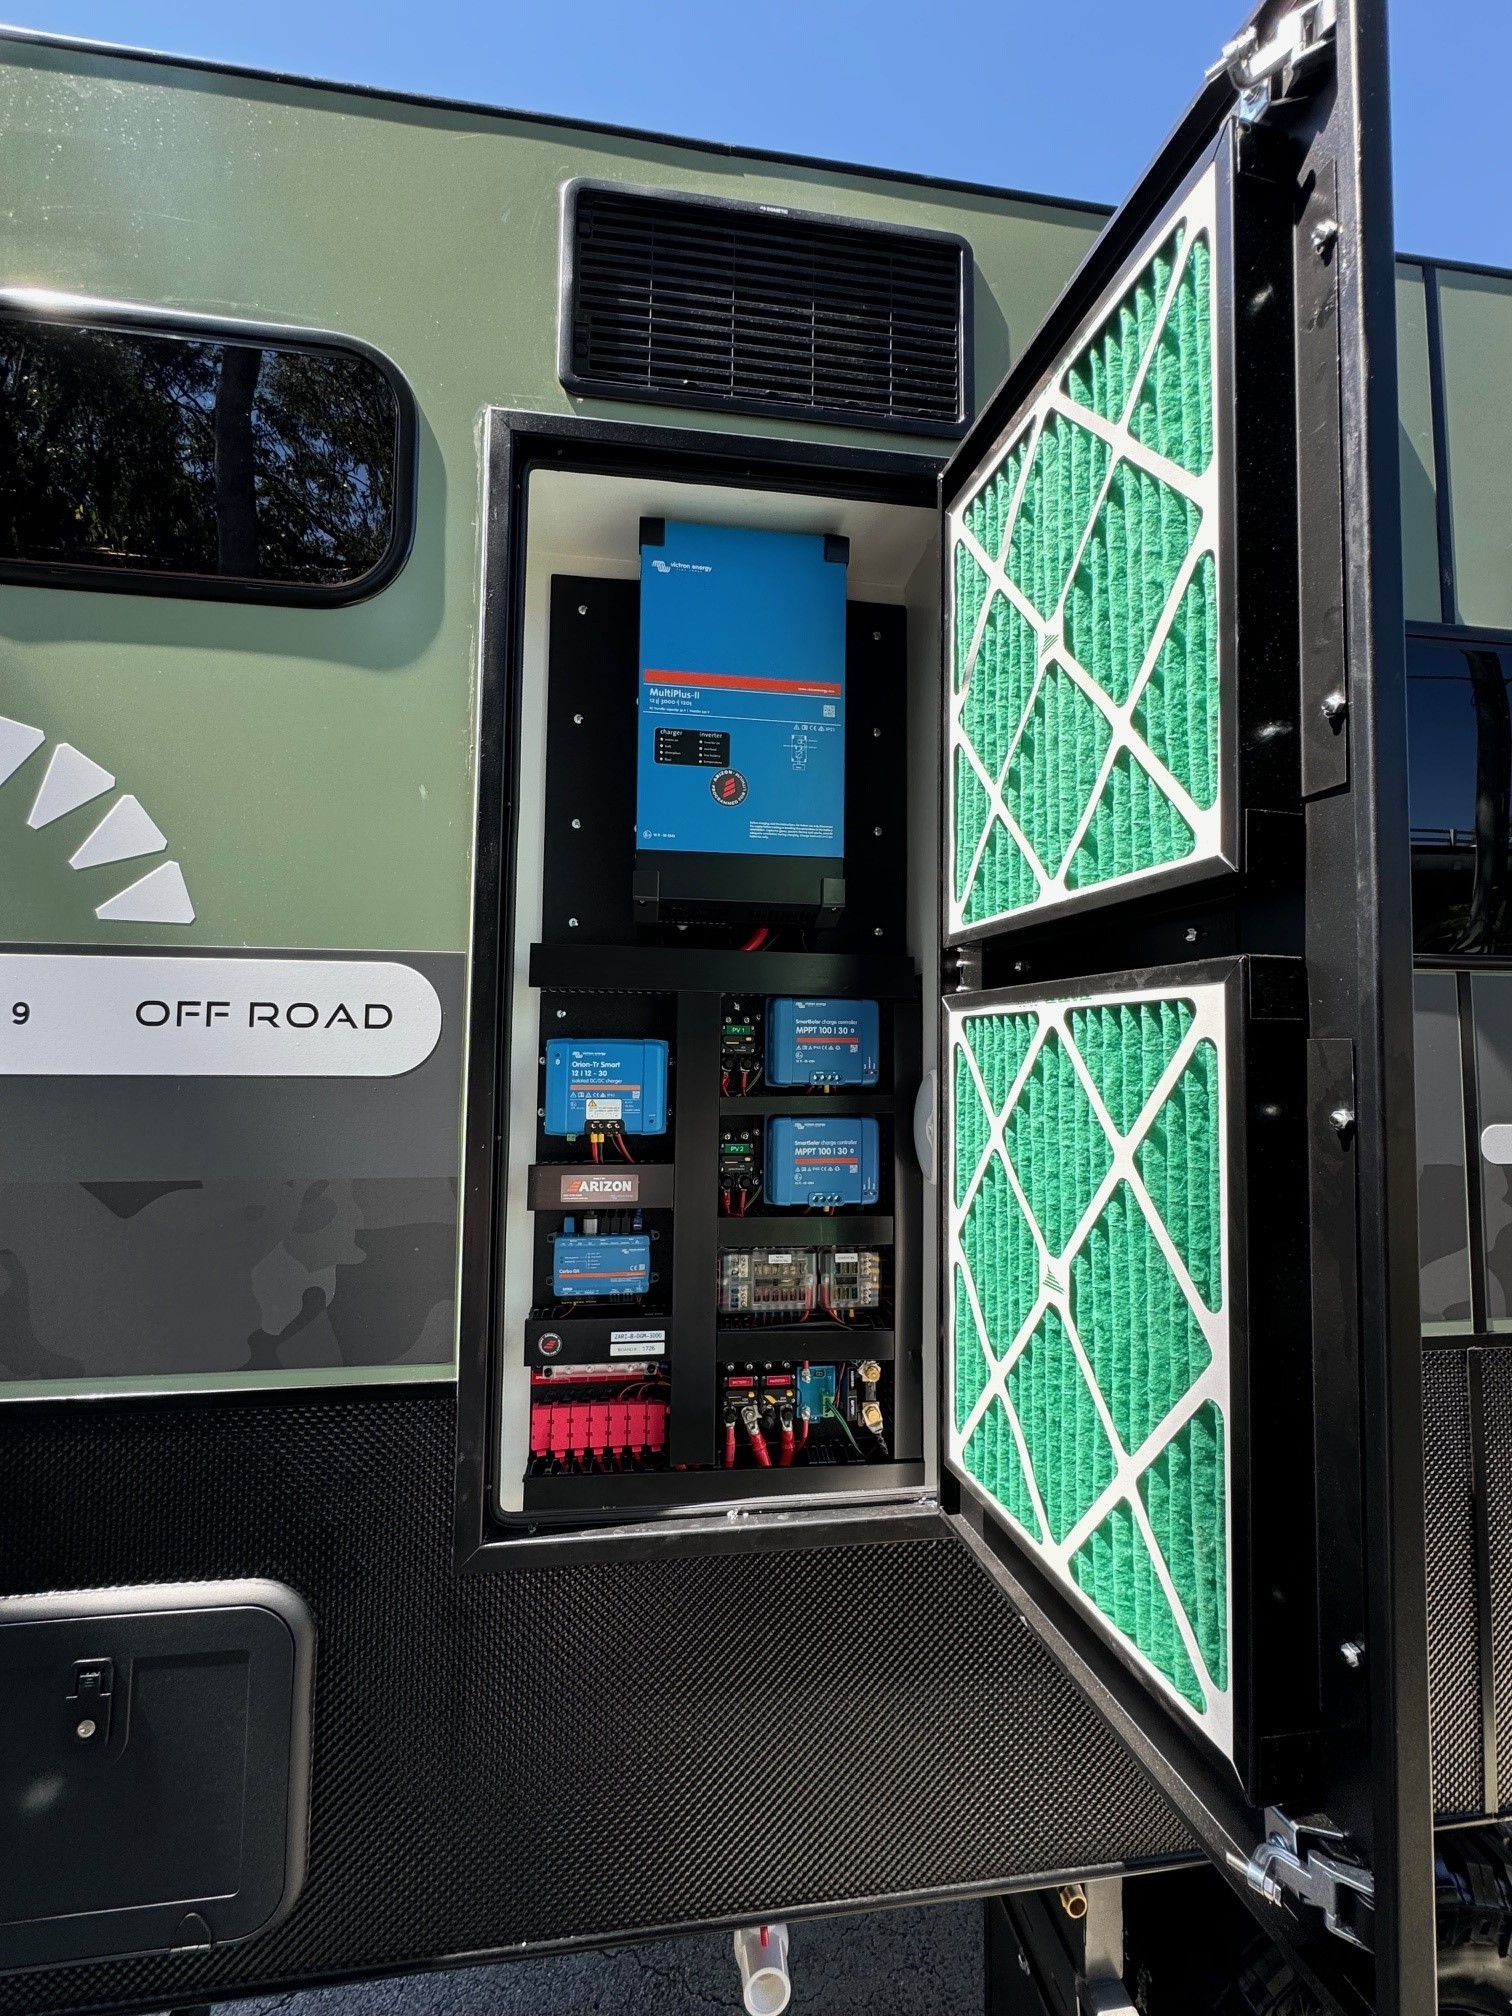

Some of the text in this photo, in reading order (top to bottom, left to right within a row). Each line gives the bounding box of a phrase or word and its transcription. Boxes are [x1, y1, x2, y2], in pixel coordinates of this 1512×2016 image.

[12, 1002, 30, 1025] 9
[136, 1000, 394, 1030] OFF ROAD
[579, 1181, 631, 1192] ARIZON
